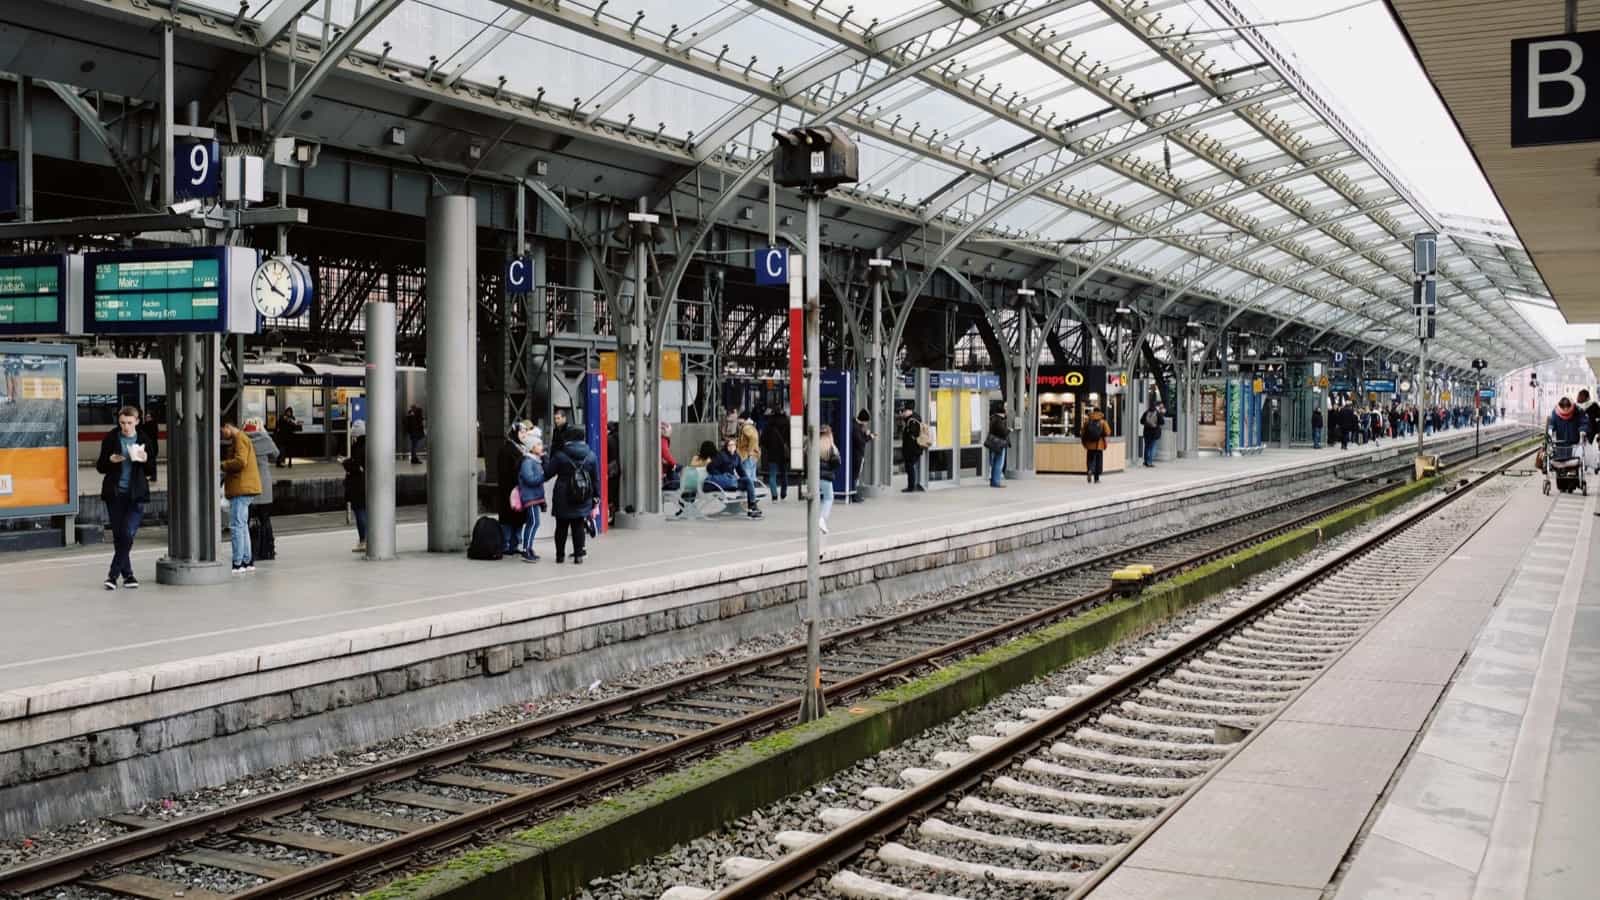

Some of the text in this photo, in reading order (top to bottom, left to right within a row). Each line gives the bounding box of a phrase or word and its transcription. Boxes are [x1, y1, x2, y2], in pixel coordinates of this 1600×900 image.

[1528, 40, 1586, 118] B
[190, 144, 209, 185] 9
[508, 260, 524, 285] C
[766, 250, 782, 277] C
[119, 278, 139, 289] Mainz
[1335, 352, 1343, 362] D
